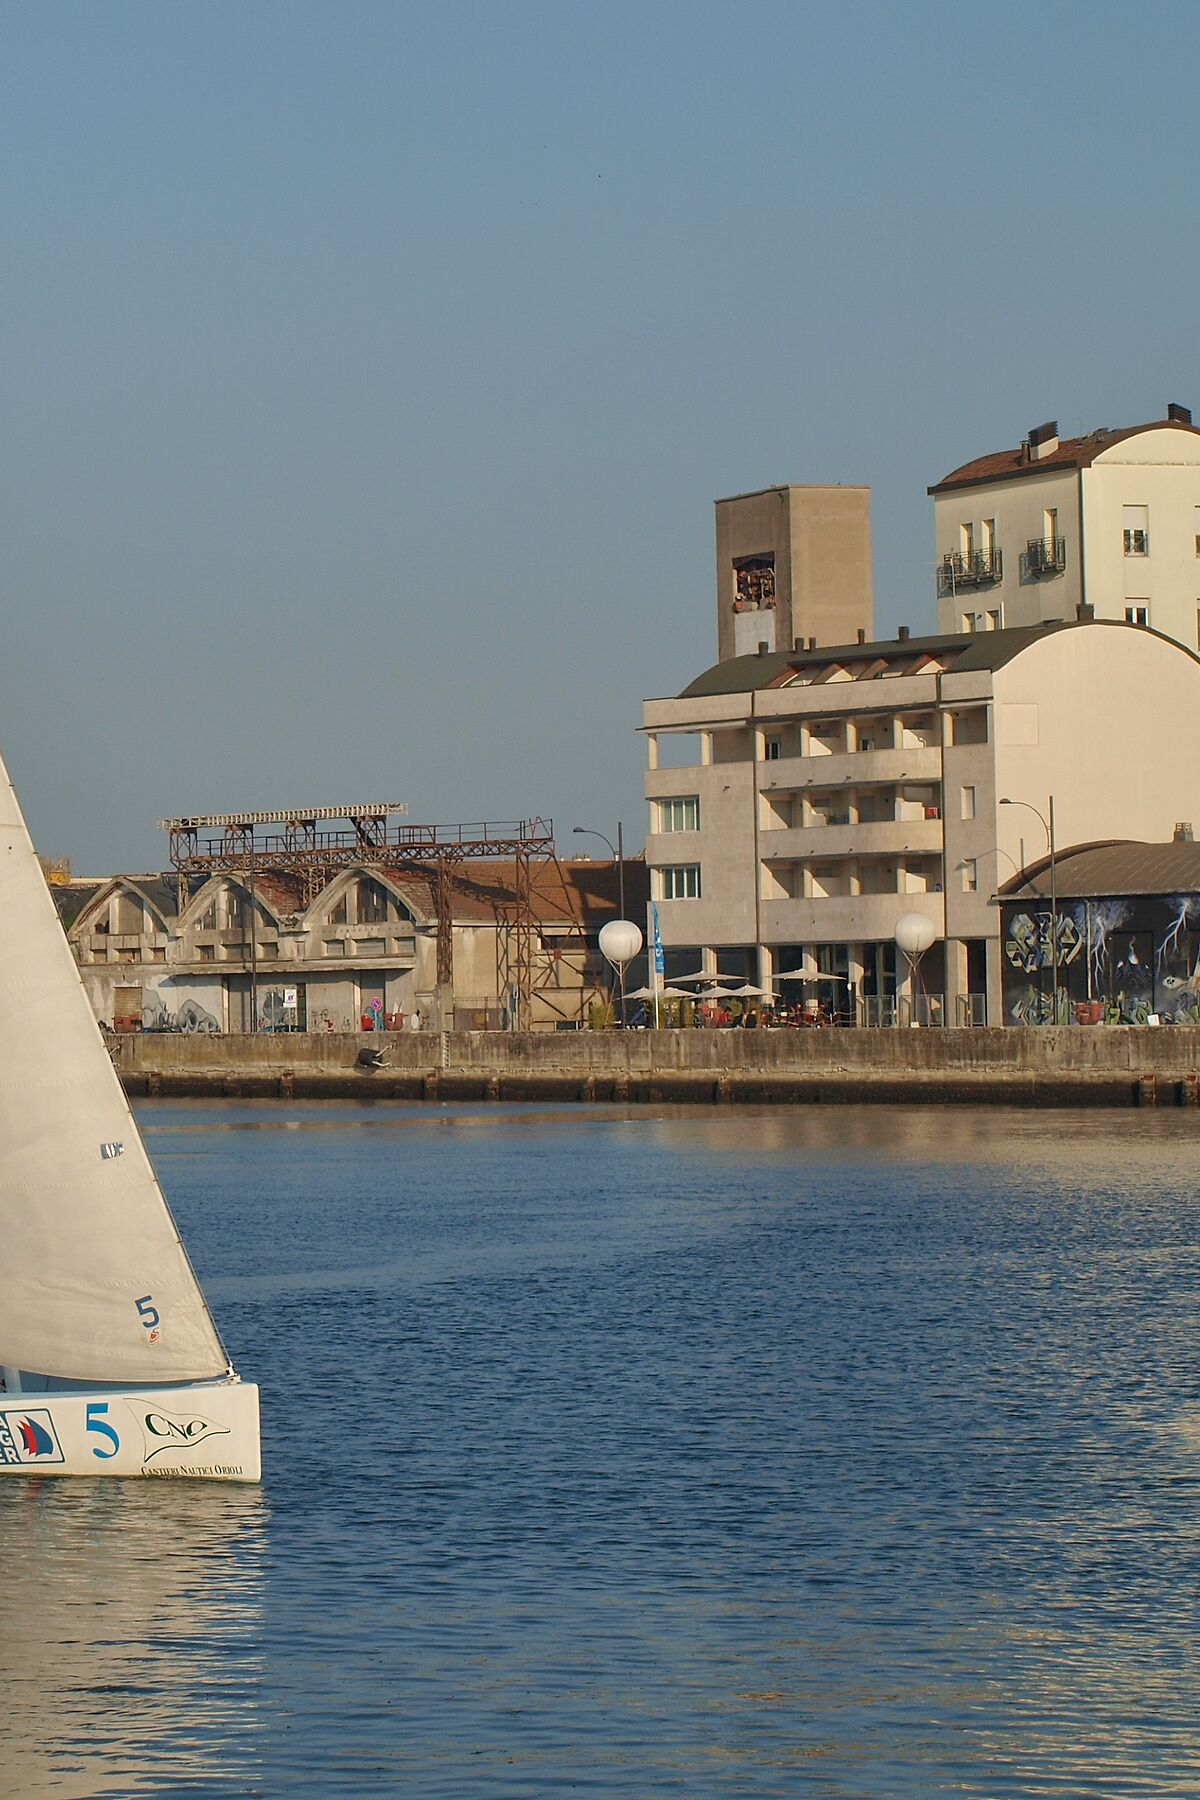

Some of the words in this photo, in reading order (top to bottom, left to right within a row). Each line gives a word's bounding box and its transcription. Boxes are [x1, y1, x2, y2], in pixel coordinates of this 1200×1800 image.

[134, 1295, 160, 1328] 5
[86, 1403, 120, 1459] 5
[214, 1464, 243, 1475] ORIOLI
